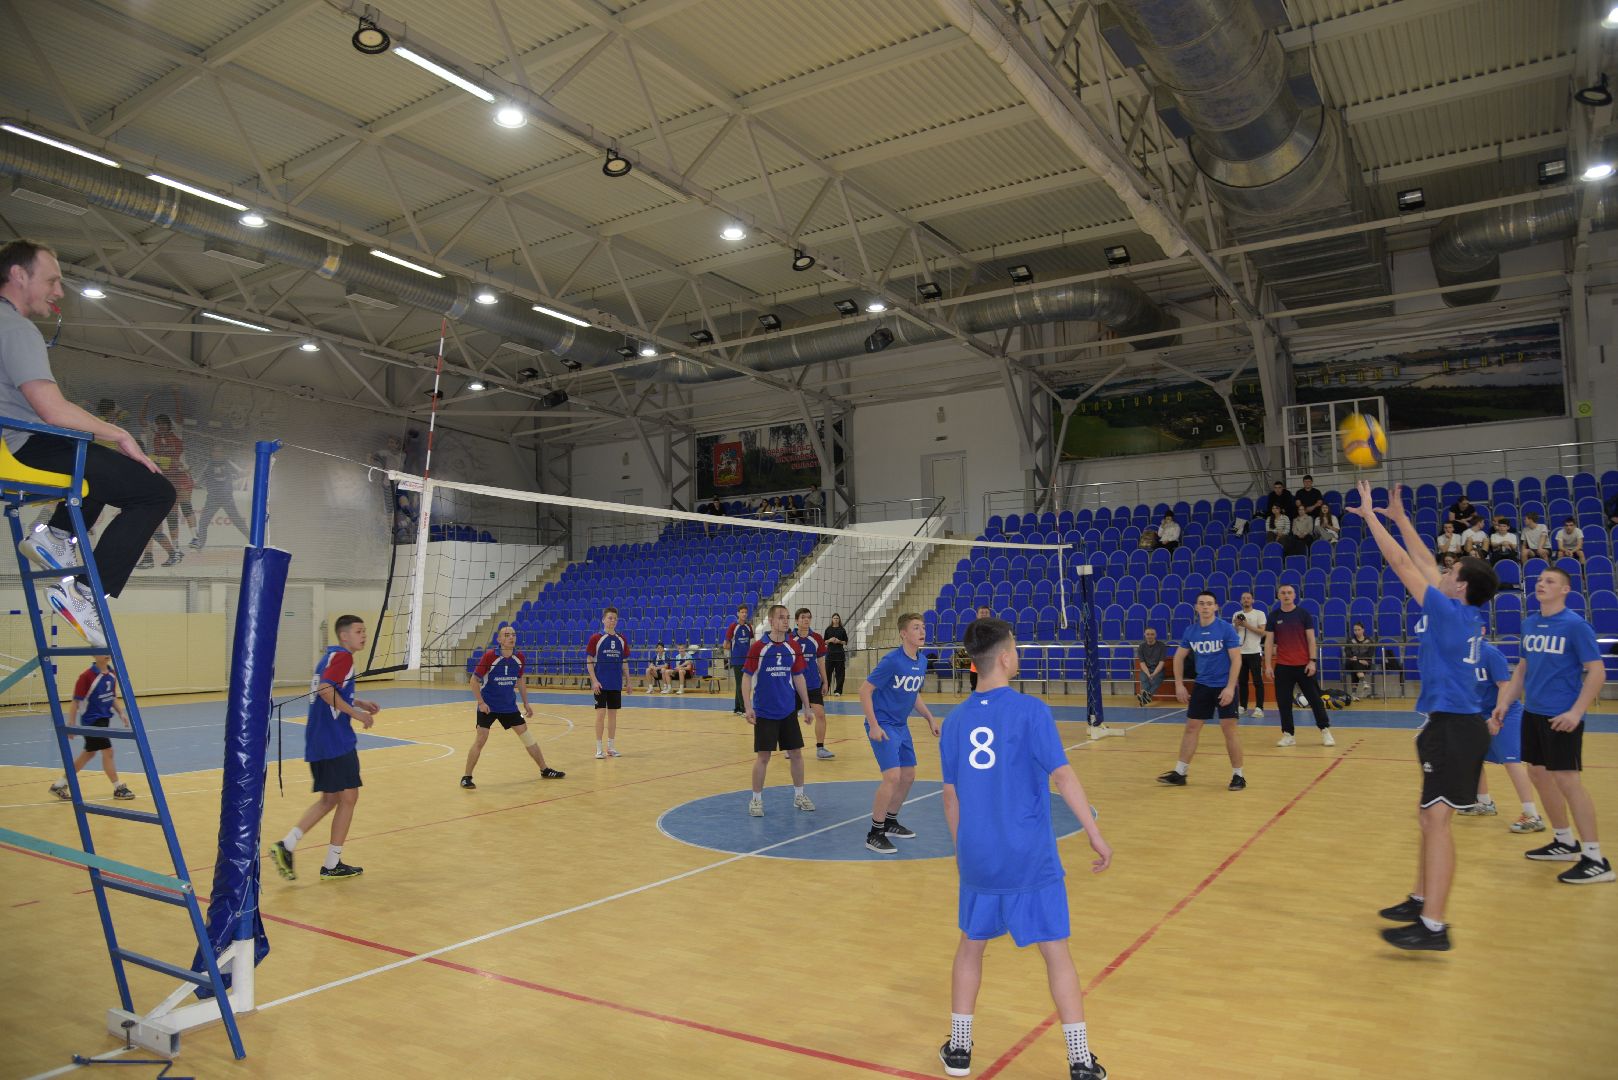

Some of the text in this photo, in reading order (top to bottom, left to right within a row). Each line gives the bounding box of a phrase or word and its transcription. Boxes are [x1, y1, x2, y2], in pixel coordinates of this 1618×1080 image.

[801, 643, 806, 653] 7
[776, 653, 782, 666] 2
[504, 665, 509, 676] 1
[968, 726, 996, 770] 8
